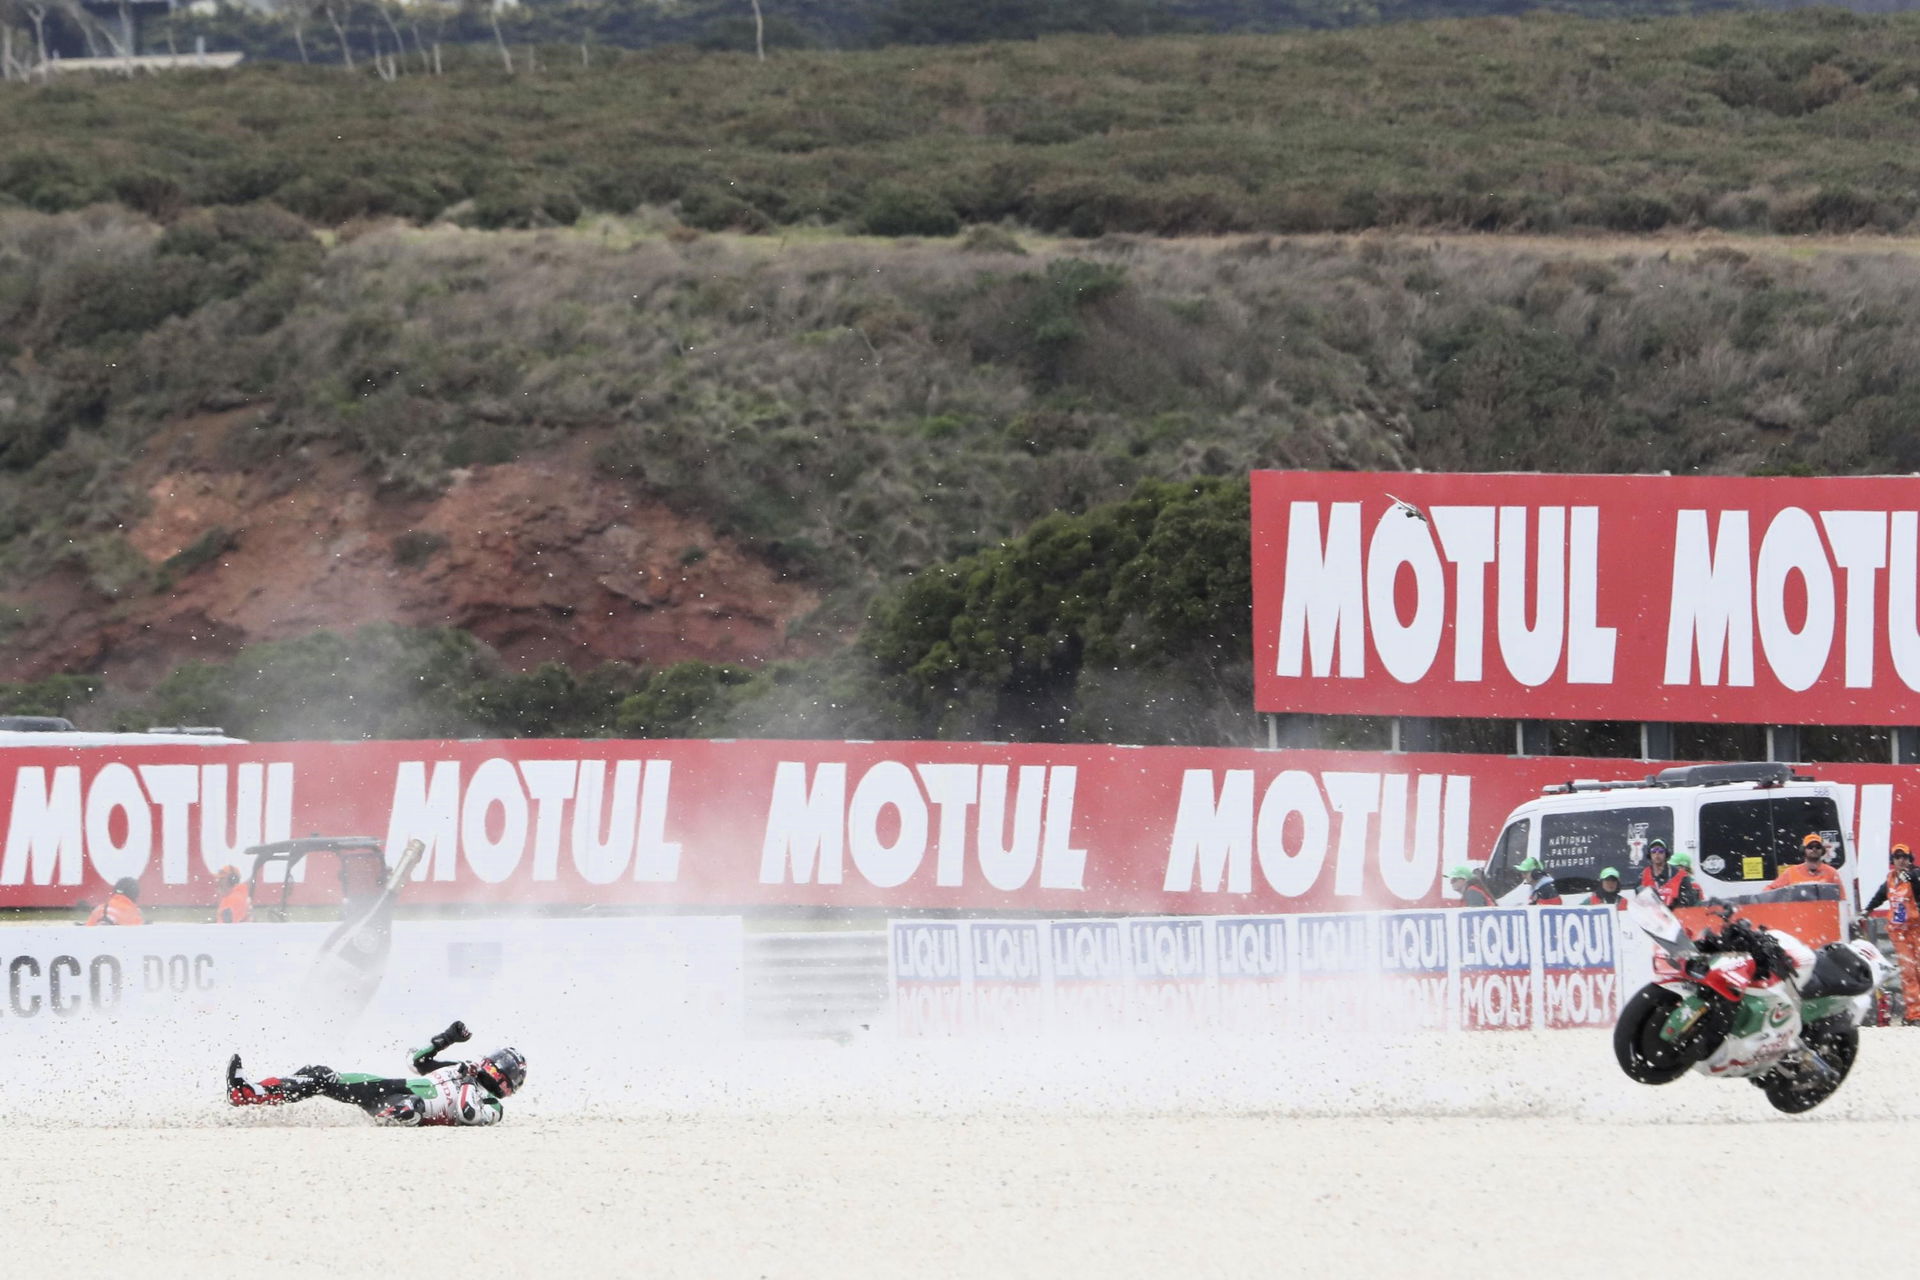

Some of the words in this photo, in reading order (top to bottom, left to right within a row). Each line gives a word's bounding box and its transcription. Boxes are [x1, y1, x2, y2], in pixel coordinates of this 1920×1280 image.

[1276, 501, 1617, 687] MOTUL
[0, 761, 305, 886] MOTUL
[386, 758, 682, 884] MOTUL
[759, 761, 1087, 891] MOTUL
[1163, 769, 1488, 900] MOTUL
[1549, 834, 1592, 846] NATIONAL
[1551, 847, 1588, 856] PATIENT
[1544, 857, 1595, 868] TRANSPORT
[897, 928, 958, 978] LIQUI
[974, 928, 1039, 979] LIQUI
[1055, 926, 1120, 978] LIQUI
[1134, 925, 1202, 977] LIQUI
[1219, 923, 1284, 974] LIQUI
[1384, 918, 1445, 969] LIQUI
[1462, 914, 1528, 967] LIQUI
[1543, 912, 1611, 966] LIQUI
[0, 955, 122, 1018] CCO
[144, 954, 214, 993] DOC
[1381, 977, 1447, 1026] OLY
[1463, 974, 1532, 1027] MOLY
[1546, 973, 1615, 1024] MOLY
